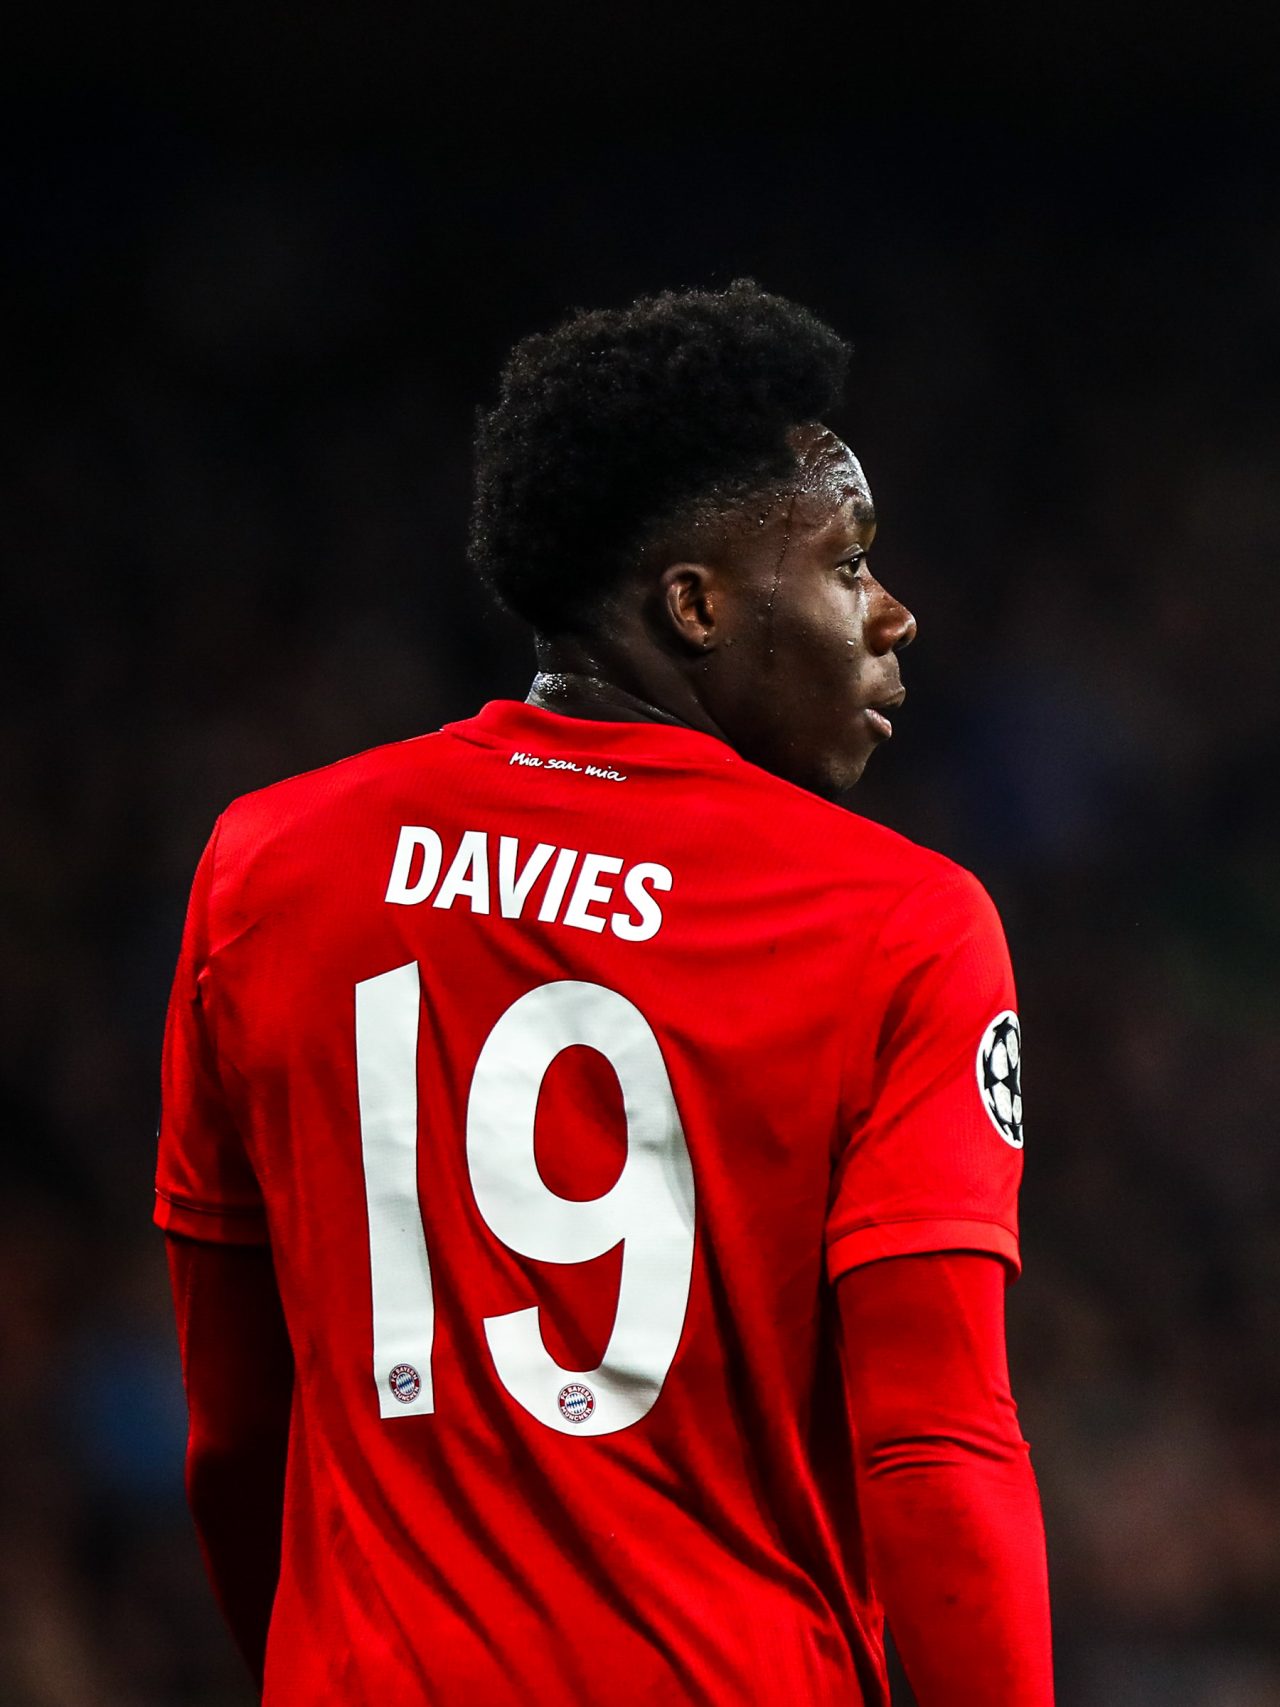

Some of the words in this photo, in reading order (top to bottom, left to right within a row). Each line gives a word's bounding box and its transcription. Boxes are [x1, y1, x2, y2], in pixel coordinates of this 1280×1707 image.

[509, 751, 543, 767] Mia
[544, 758, 583, 772] san
[584, 765, 627, 782] mia
[384, 825, 673, 942] DAVIES
[355, 960, 696, 1438] 19
